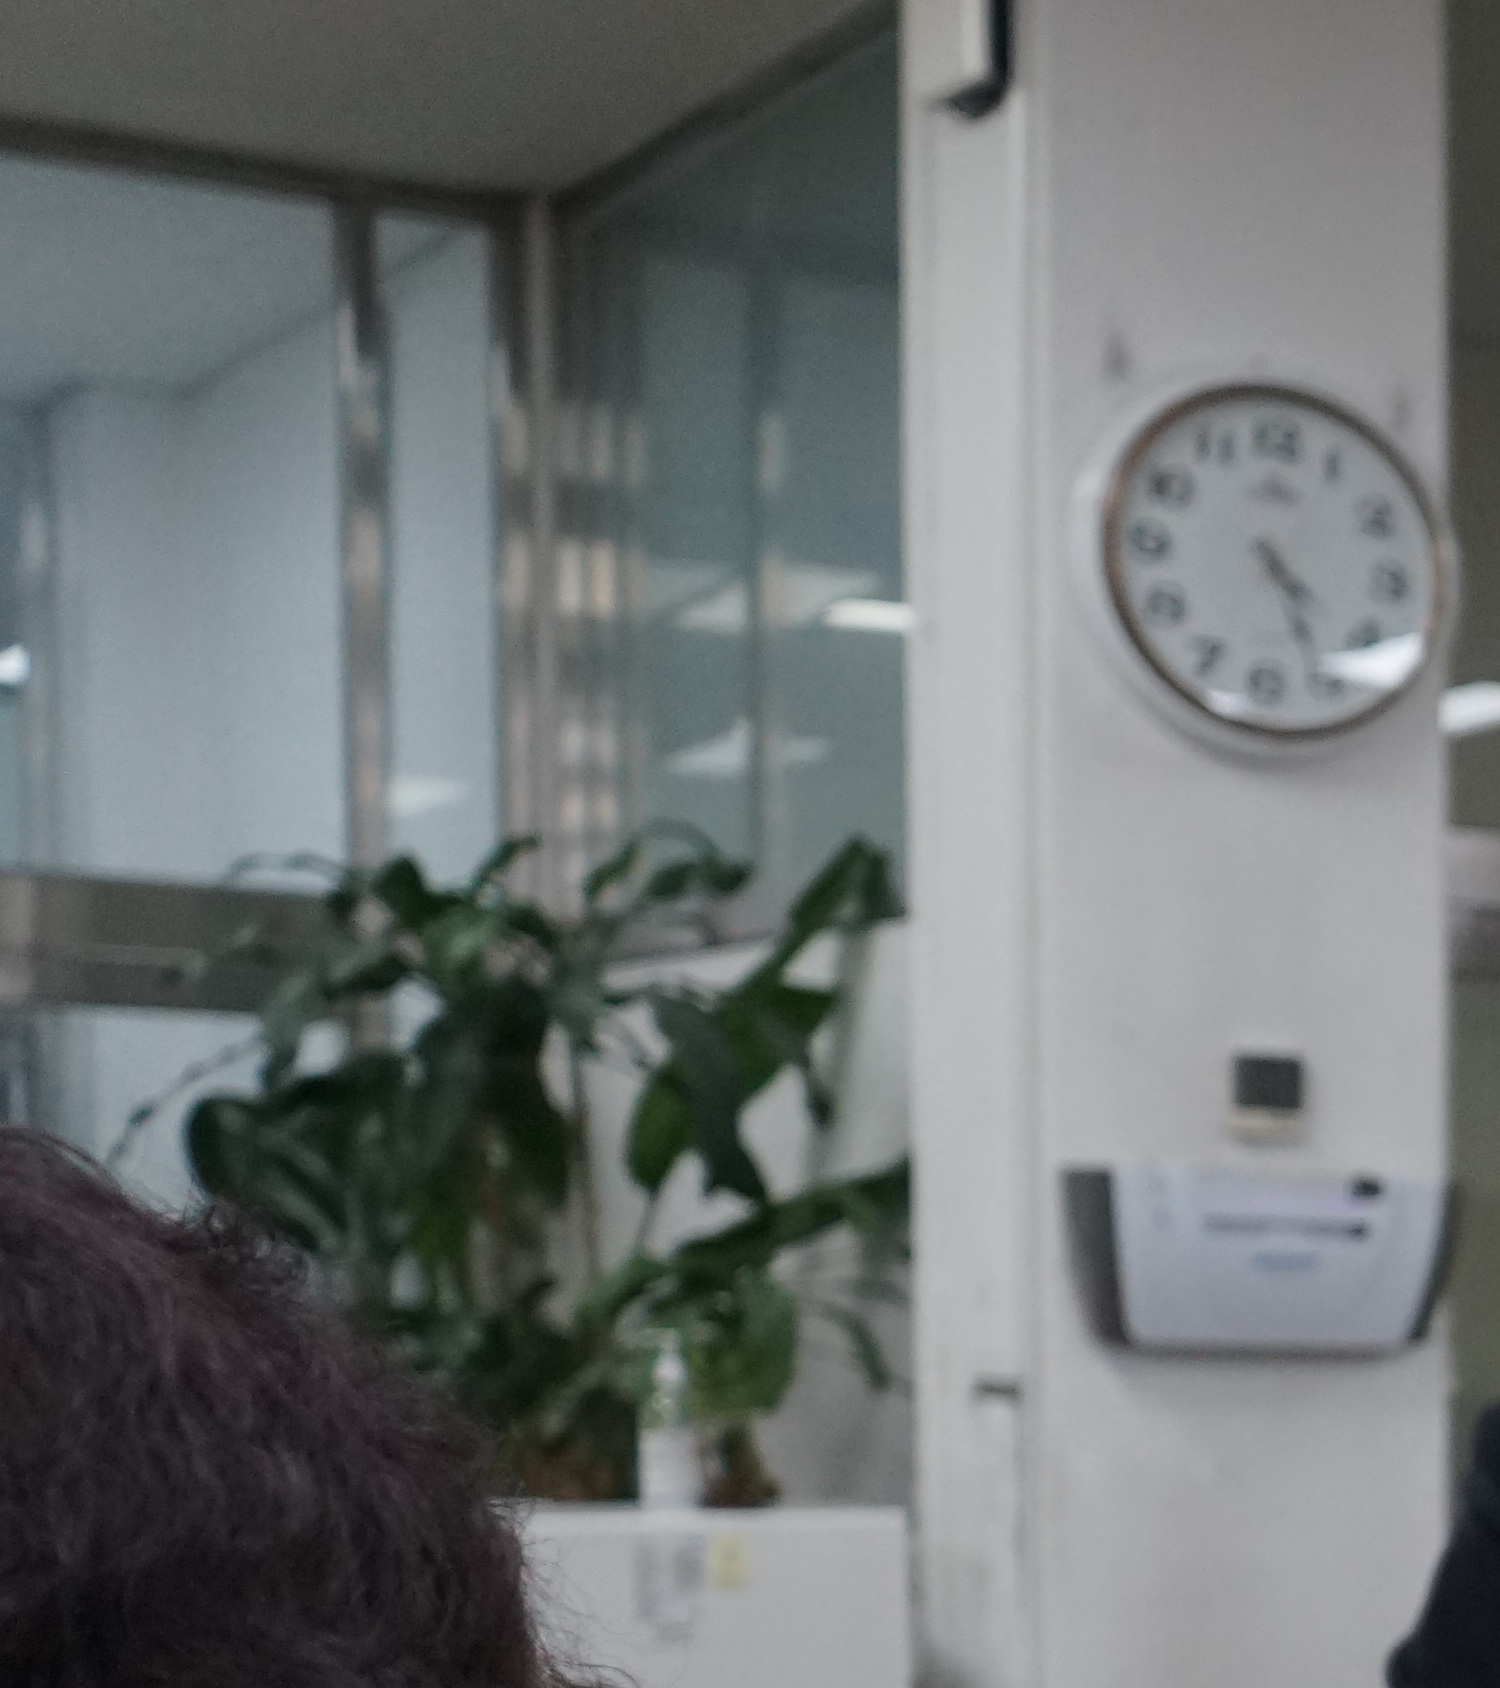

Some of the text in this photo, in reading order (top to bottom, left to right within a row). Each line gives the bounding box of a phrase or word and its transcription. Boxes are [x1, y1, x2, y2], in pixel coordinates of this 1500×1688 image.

[1196, 424, 1234, 464] 11
[1253, 422, 1301, 462] 12
[1150, 468, 1194, 507] 10
[1357, 497, 1394, 538] 2
[1130, 520, 1171, 560] 9
[1373, 561, 1408, 601] 3
[1190, 638, 1224, 674] 7
